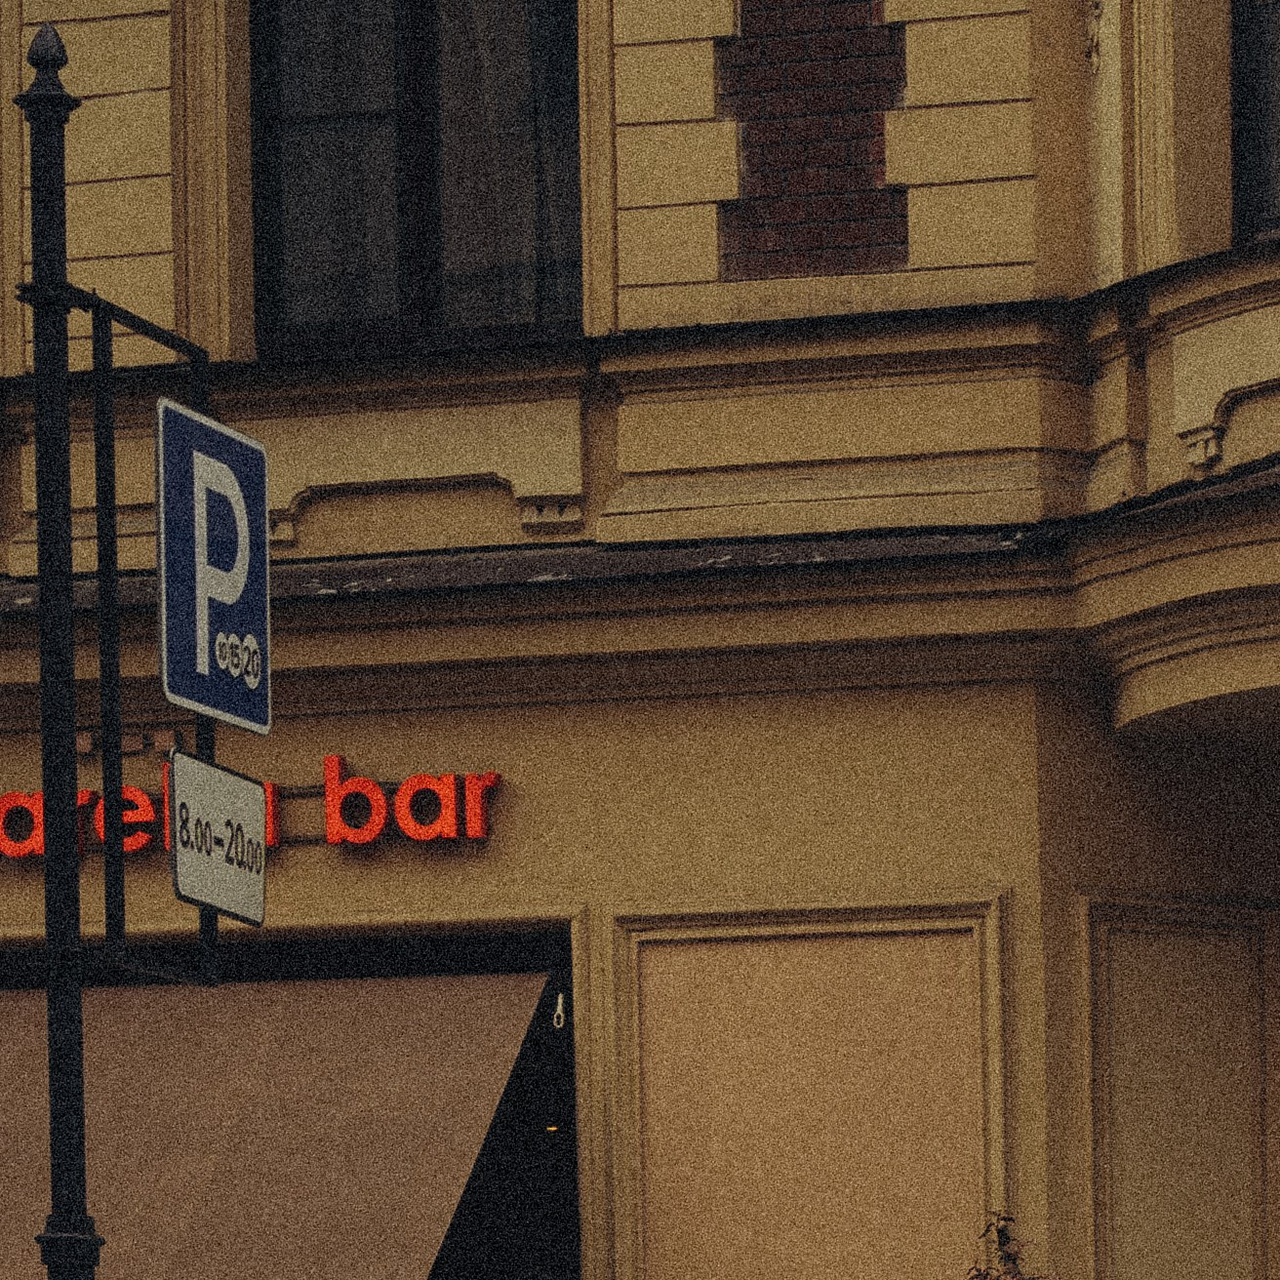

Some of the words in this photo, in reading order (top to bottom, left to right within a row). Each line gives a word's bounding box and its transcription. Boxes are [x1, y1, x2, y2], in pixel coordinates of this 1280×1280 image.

[192, 450, 250, 675] P
[243, 645, 260, 679] 20
[179, 801, 263, 875] 8.00-20.00
[324, 754, 498, 844] bar
